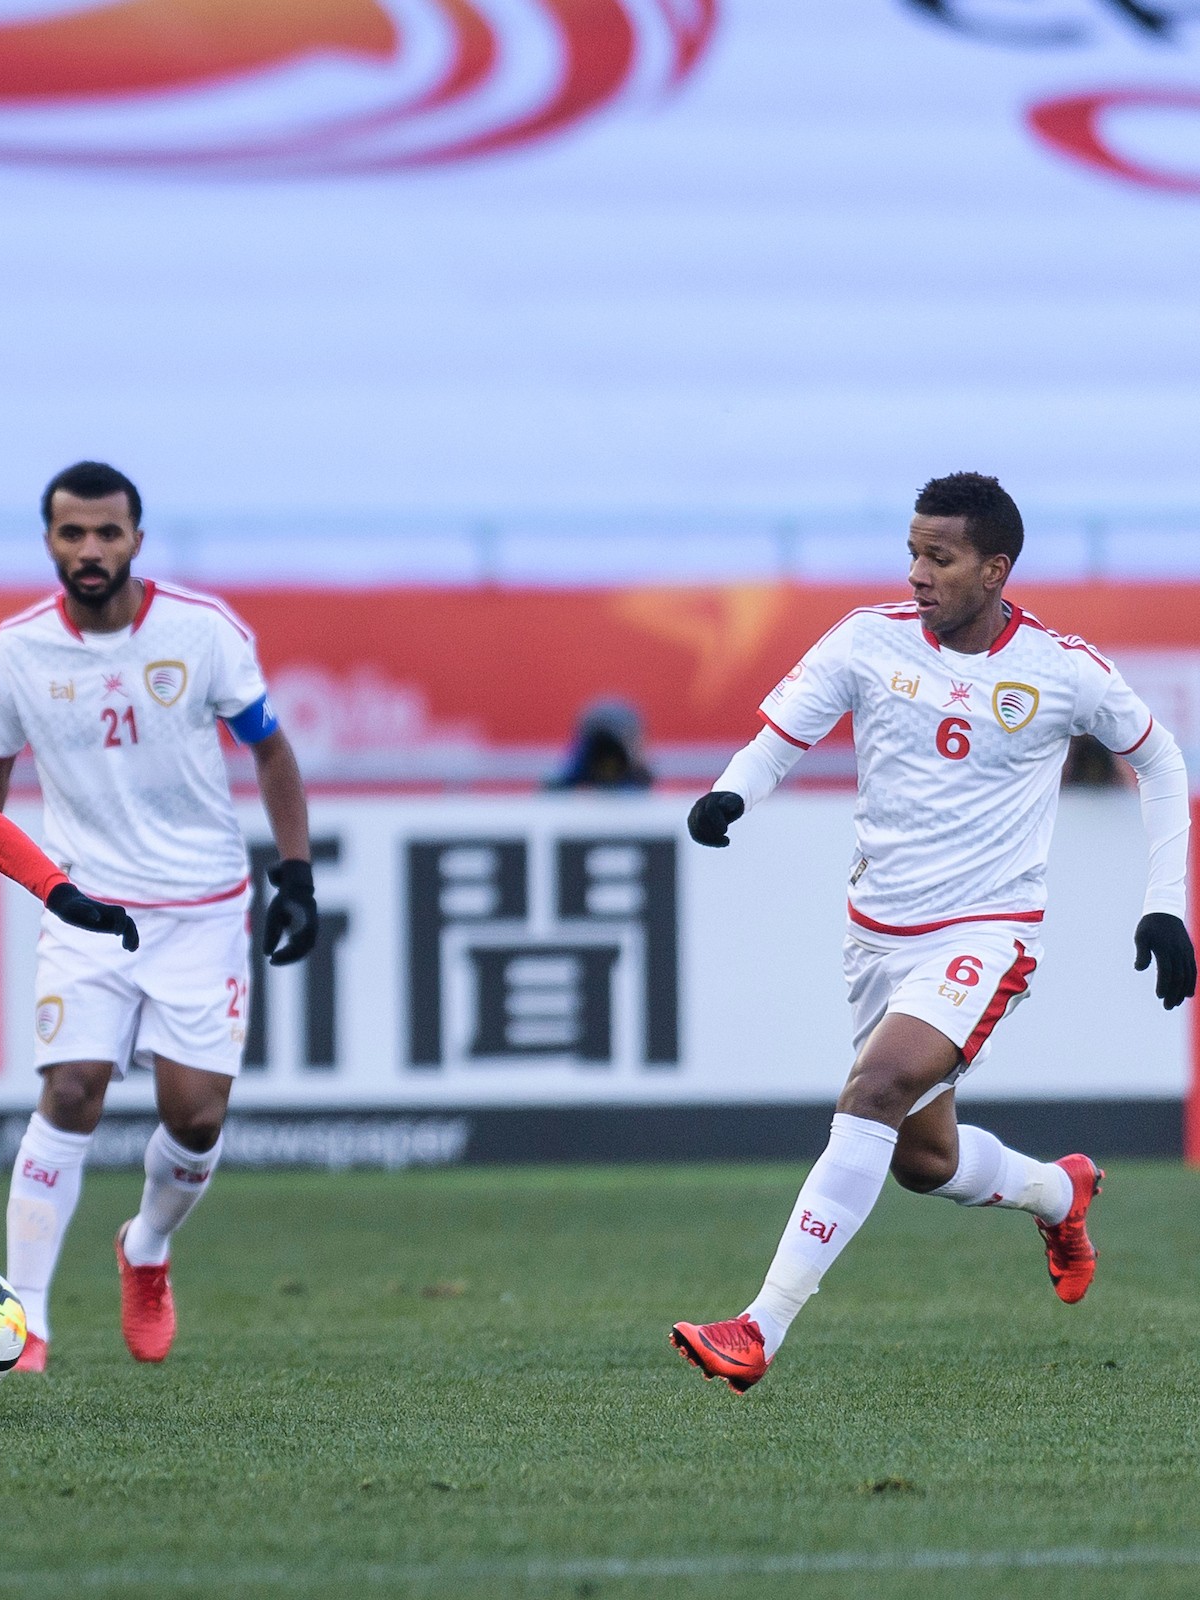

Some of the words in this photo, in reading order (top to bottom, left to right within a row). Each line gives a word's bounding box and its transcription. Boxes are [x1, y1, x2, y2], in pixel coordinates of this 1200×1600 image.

[49, 679, 75, 702] taj
[890, 671, 921, 699] taj
[101, 705, 138, 748] 21
[936, 716, 972, 760] 6
[946, 955, 983, 987] 6
[938, 980, 968, 1007] taj
[22, 1157, 60, 1189] taj
[800, 1209, 838, 1244] taj
